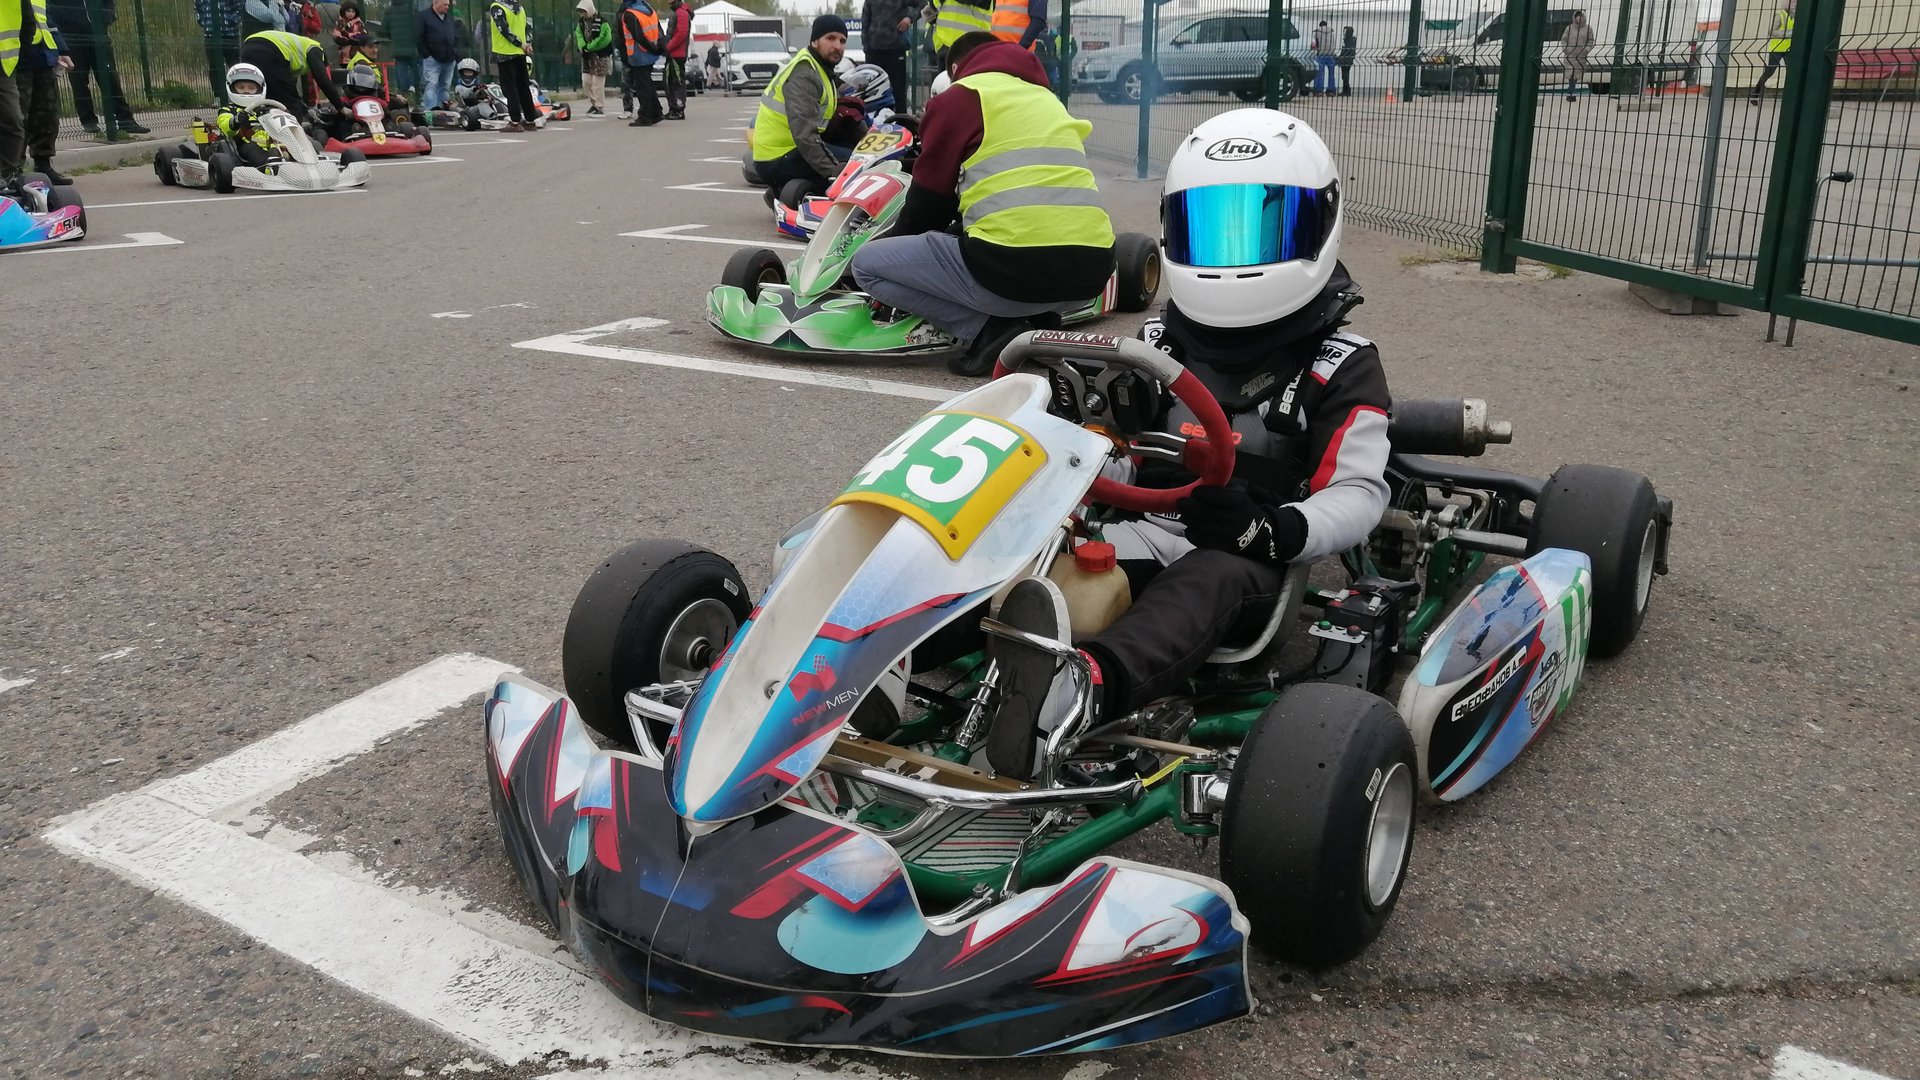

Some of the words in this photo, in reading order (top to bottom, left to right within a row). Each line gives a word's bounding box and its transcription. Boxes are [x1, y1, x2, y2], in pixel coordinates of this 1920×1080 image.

[369, 103, 379, 114] 5
[857, 135, 895, 153] 85
[1208, 141, 1260, 157] Arai
[840, 174, 890, 201] 17
[54, 214, 80, 235] ART
[1317, 346, 1343, 360] MP
[854, 414, 1020, 503] 45
